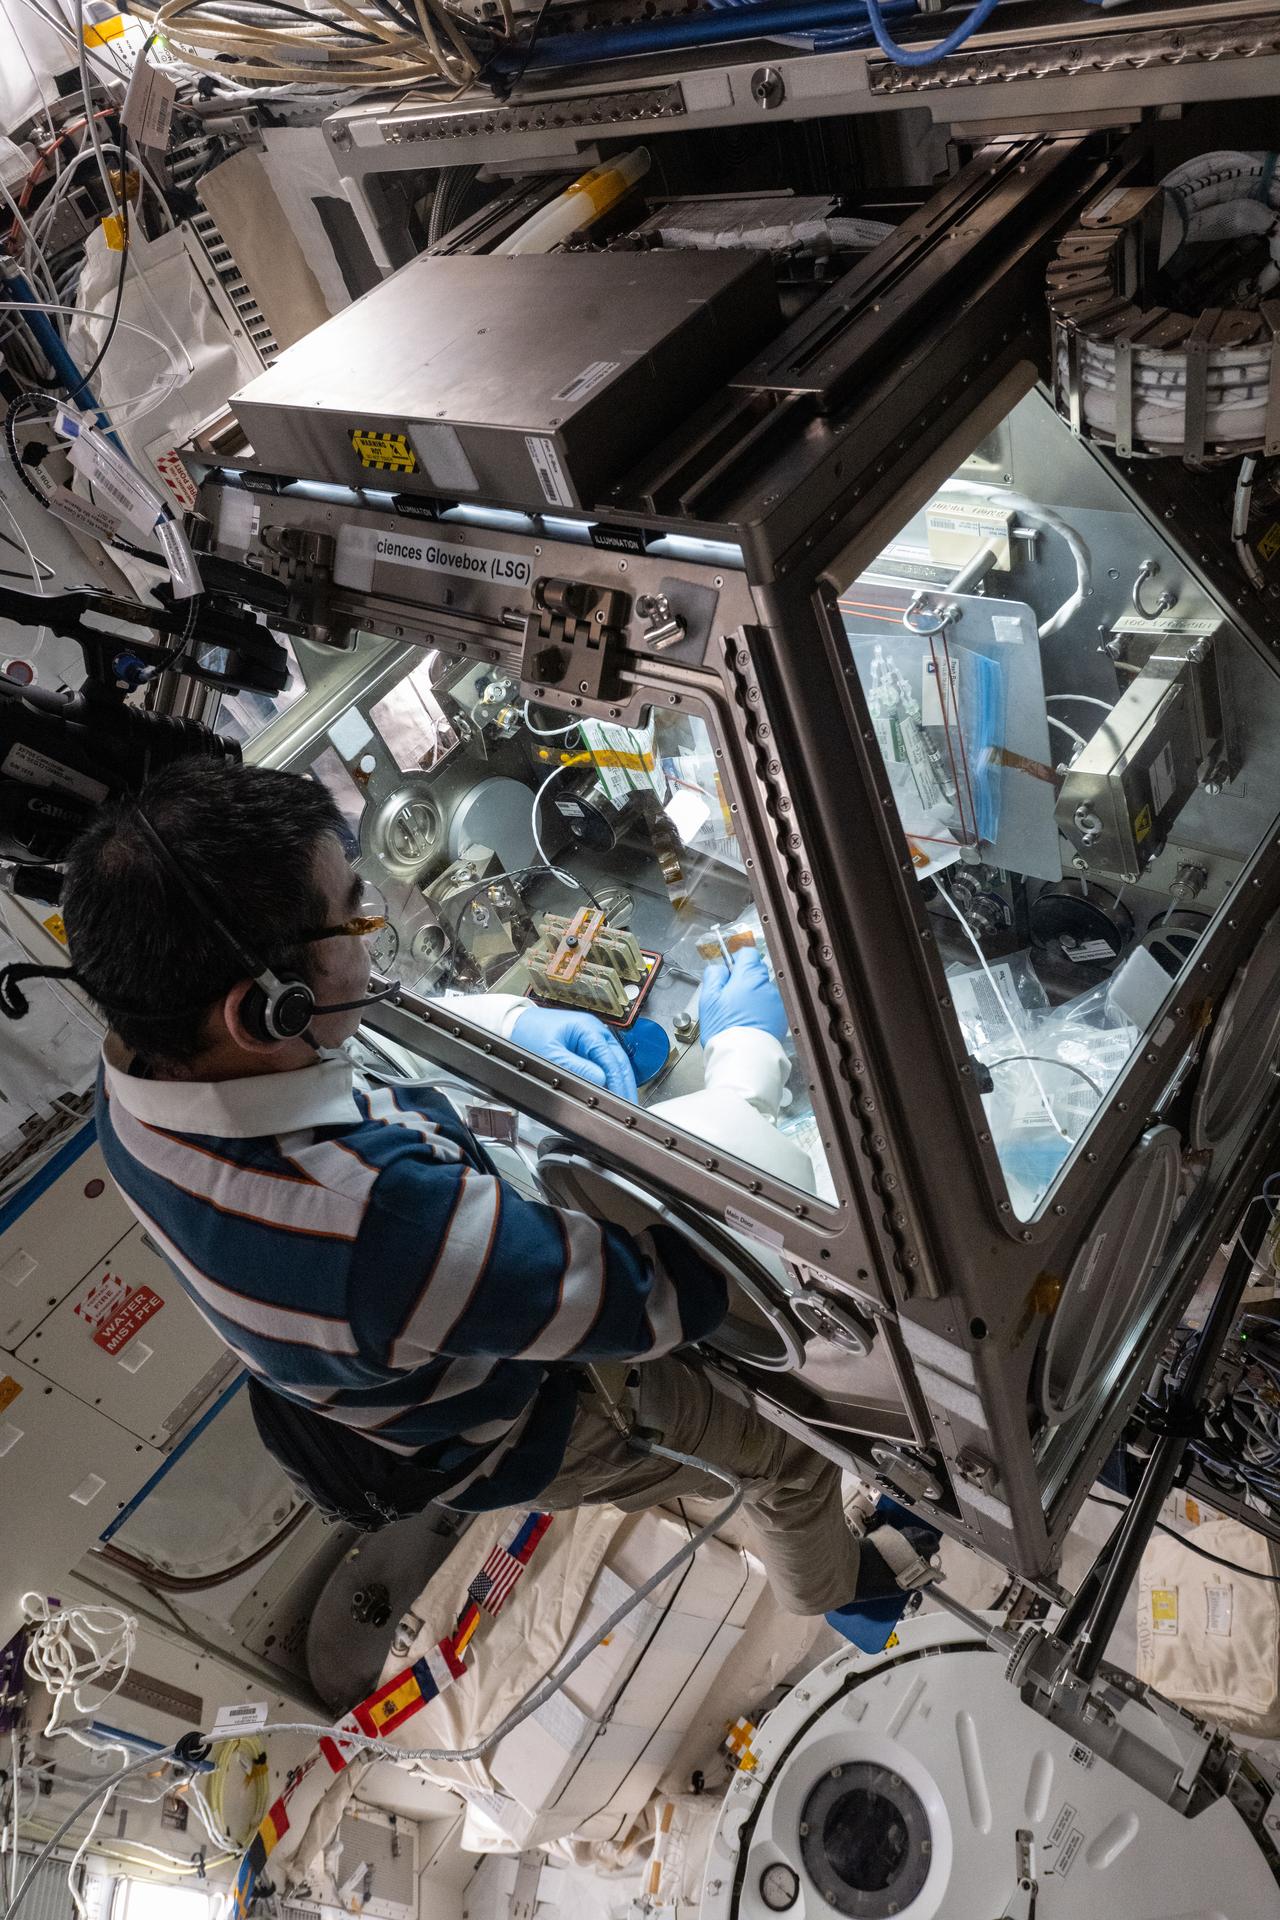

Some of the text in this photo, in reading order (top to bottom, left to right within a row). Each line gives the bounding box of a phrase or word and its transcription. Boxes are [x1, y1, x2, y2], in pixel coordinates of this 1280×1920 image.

[360, 439, 386, 448] WARNING
[370, 447, 382, 455] HOT
[174, 463, 189, 482] PORT
[398, 504, 432, 517] ILLUMINATION
[595, 536, 639, 549] ILLUMINATION
[376, 538, 531, 585] ciences Glovebox (LSG)
[26, 797, 84, 822] Canon
[726, 1209, 754, 1228] Main Door
[95, 1291, 113, 1308] FIRE
[103, 1294, 147, 1337] WATER
[107, 1297, 161, 1350] MIST PFE
